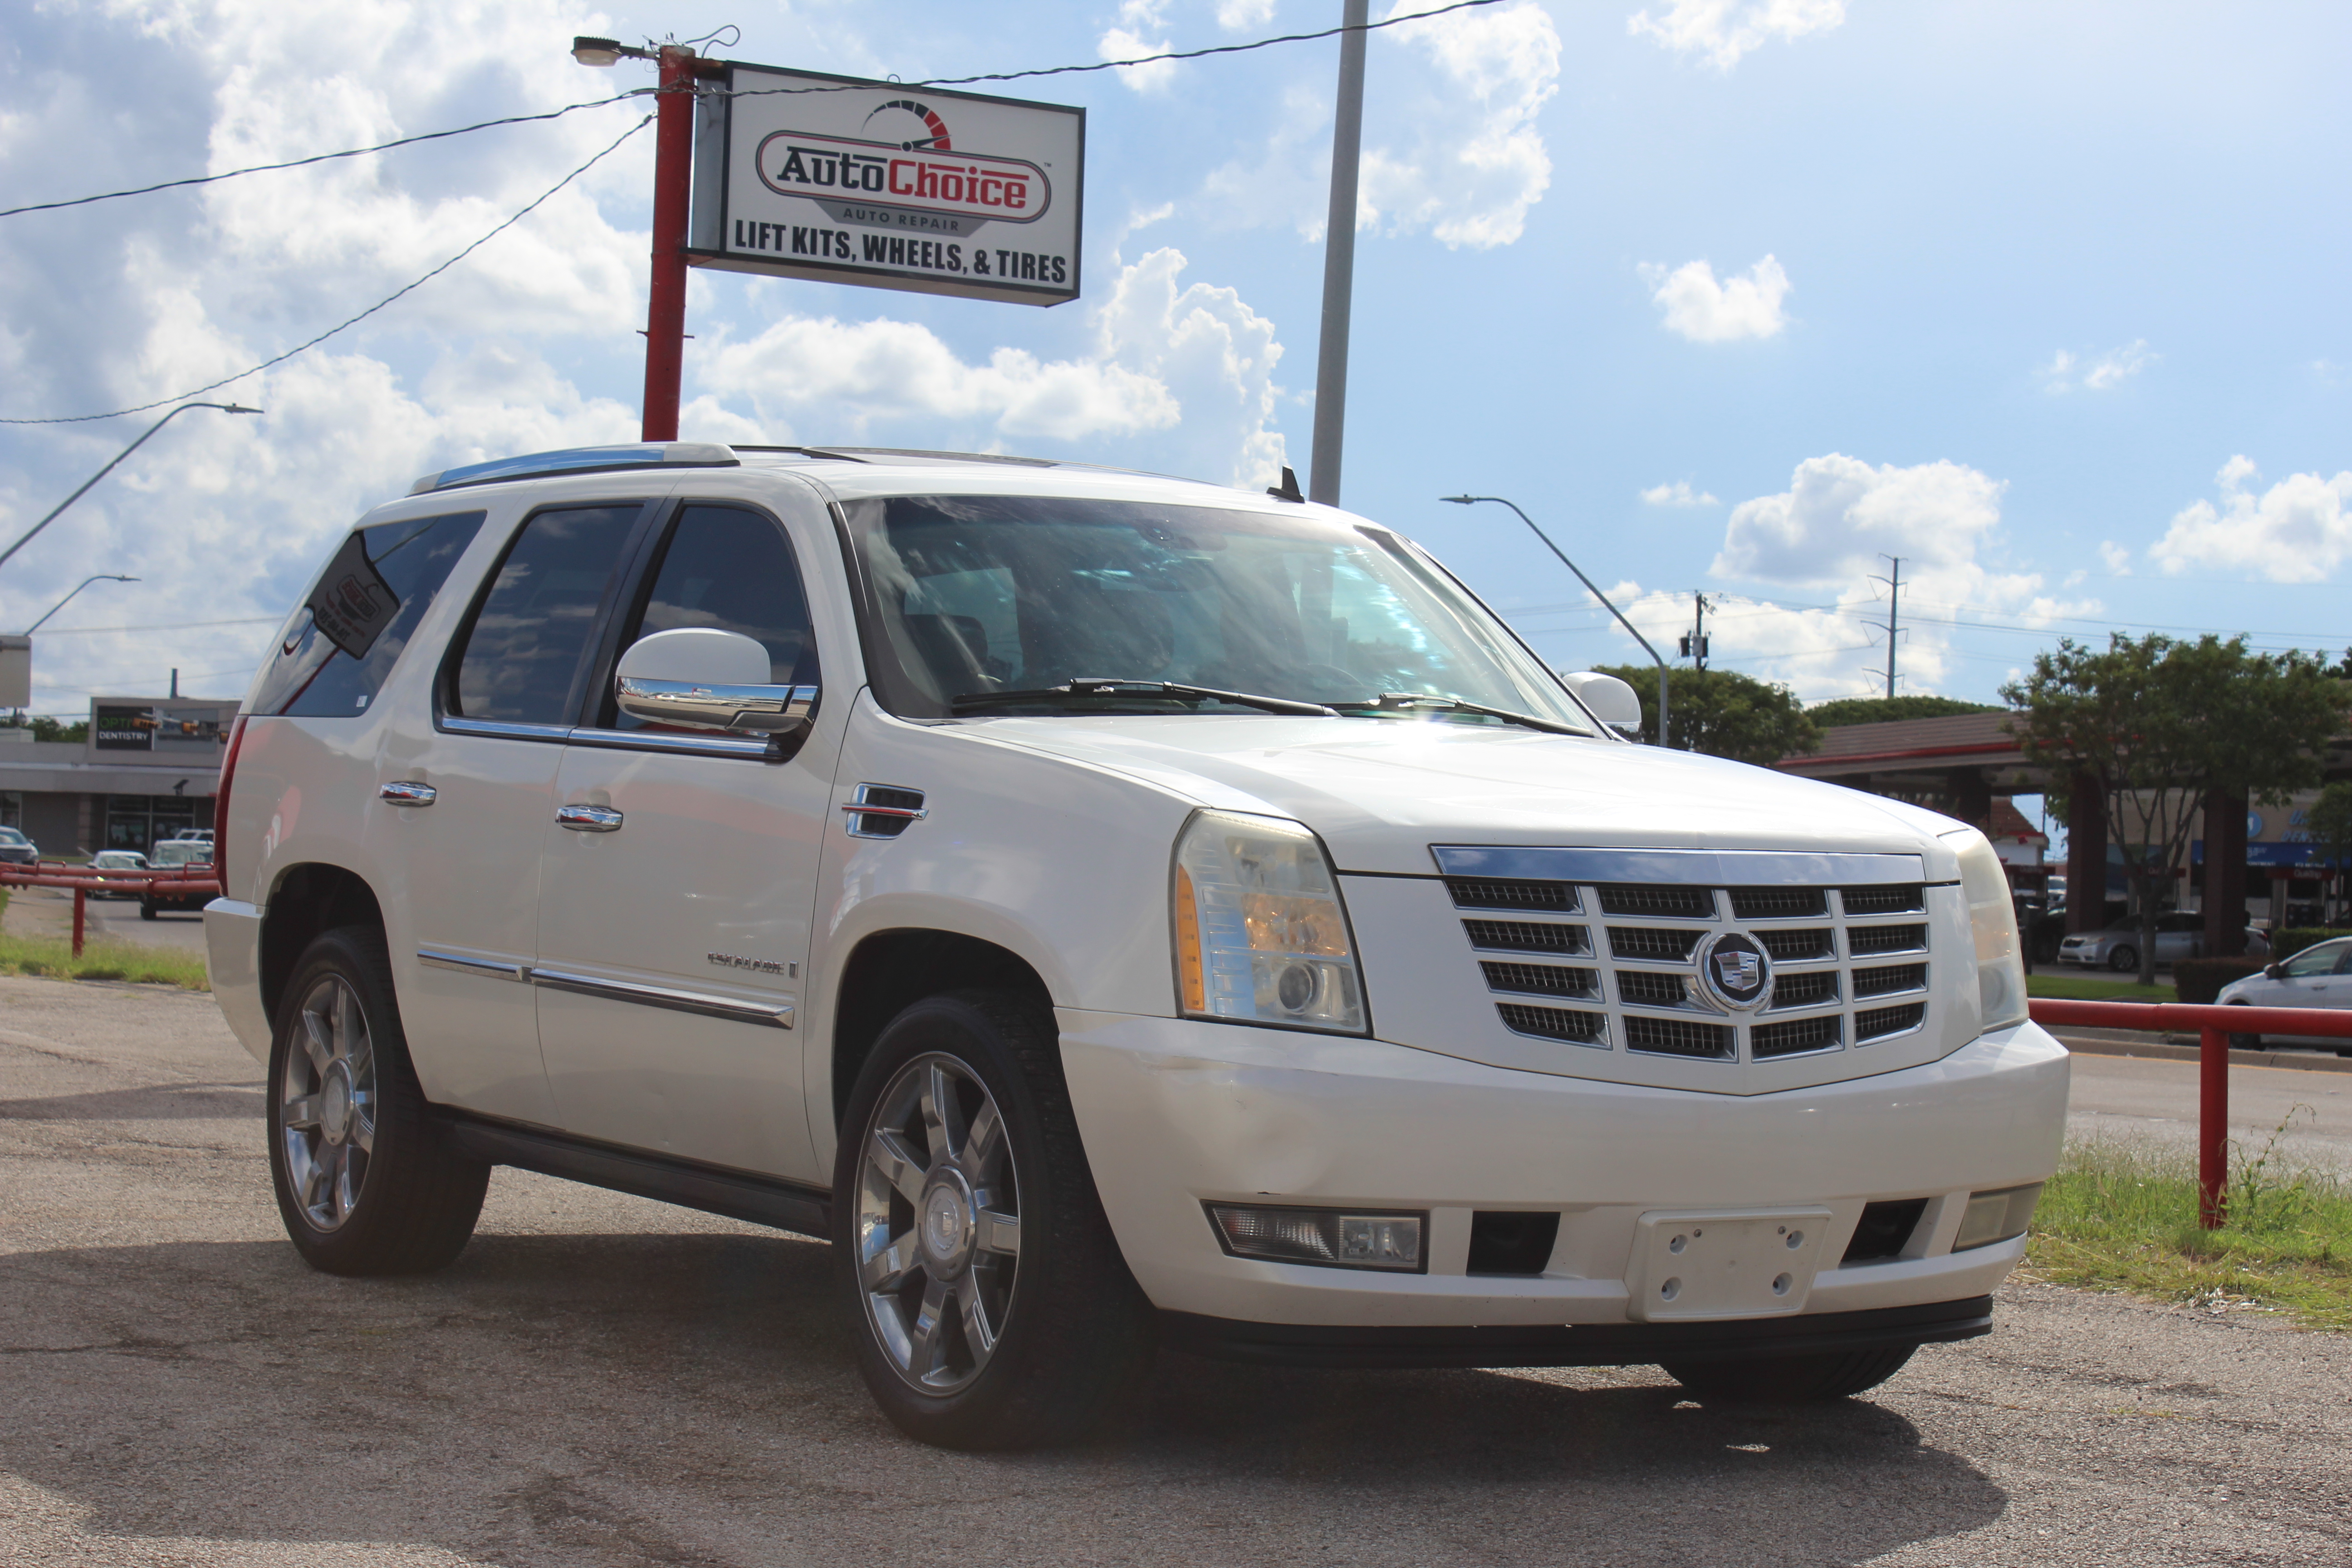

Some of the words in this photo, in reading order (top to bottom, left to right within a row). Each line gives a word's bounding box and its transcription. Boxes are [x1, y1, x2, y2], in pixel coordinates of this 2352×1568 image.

[777, 146, 1029, 209] AutoChoice
[843, 208, 890, 223] AUTO
[898, 214, 959, 231] REPAIR
[735, 220, 786, 251] LIFT
[792, 226, 857, 262] KITS,
[863, 234, 968, 275] WHEELS,
[973, 249, 990, 275] &
[996, 250, 1066, 284] TIRES
[99, 731, 148, 740] DENTISTRY
